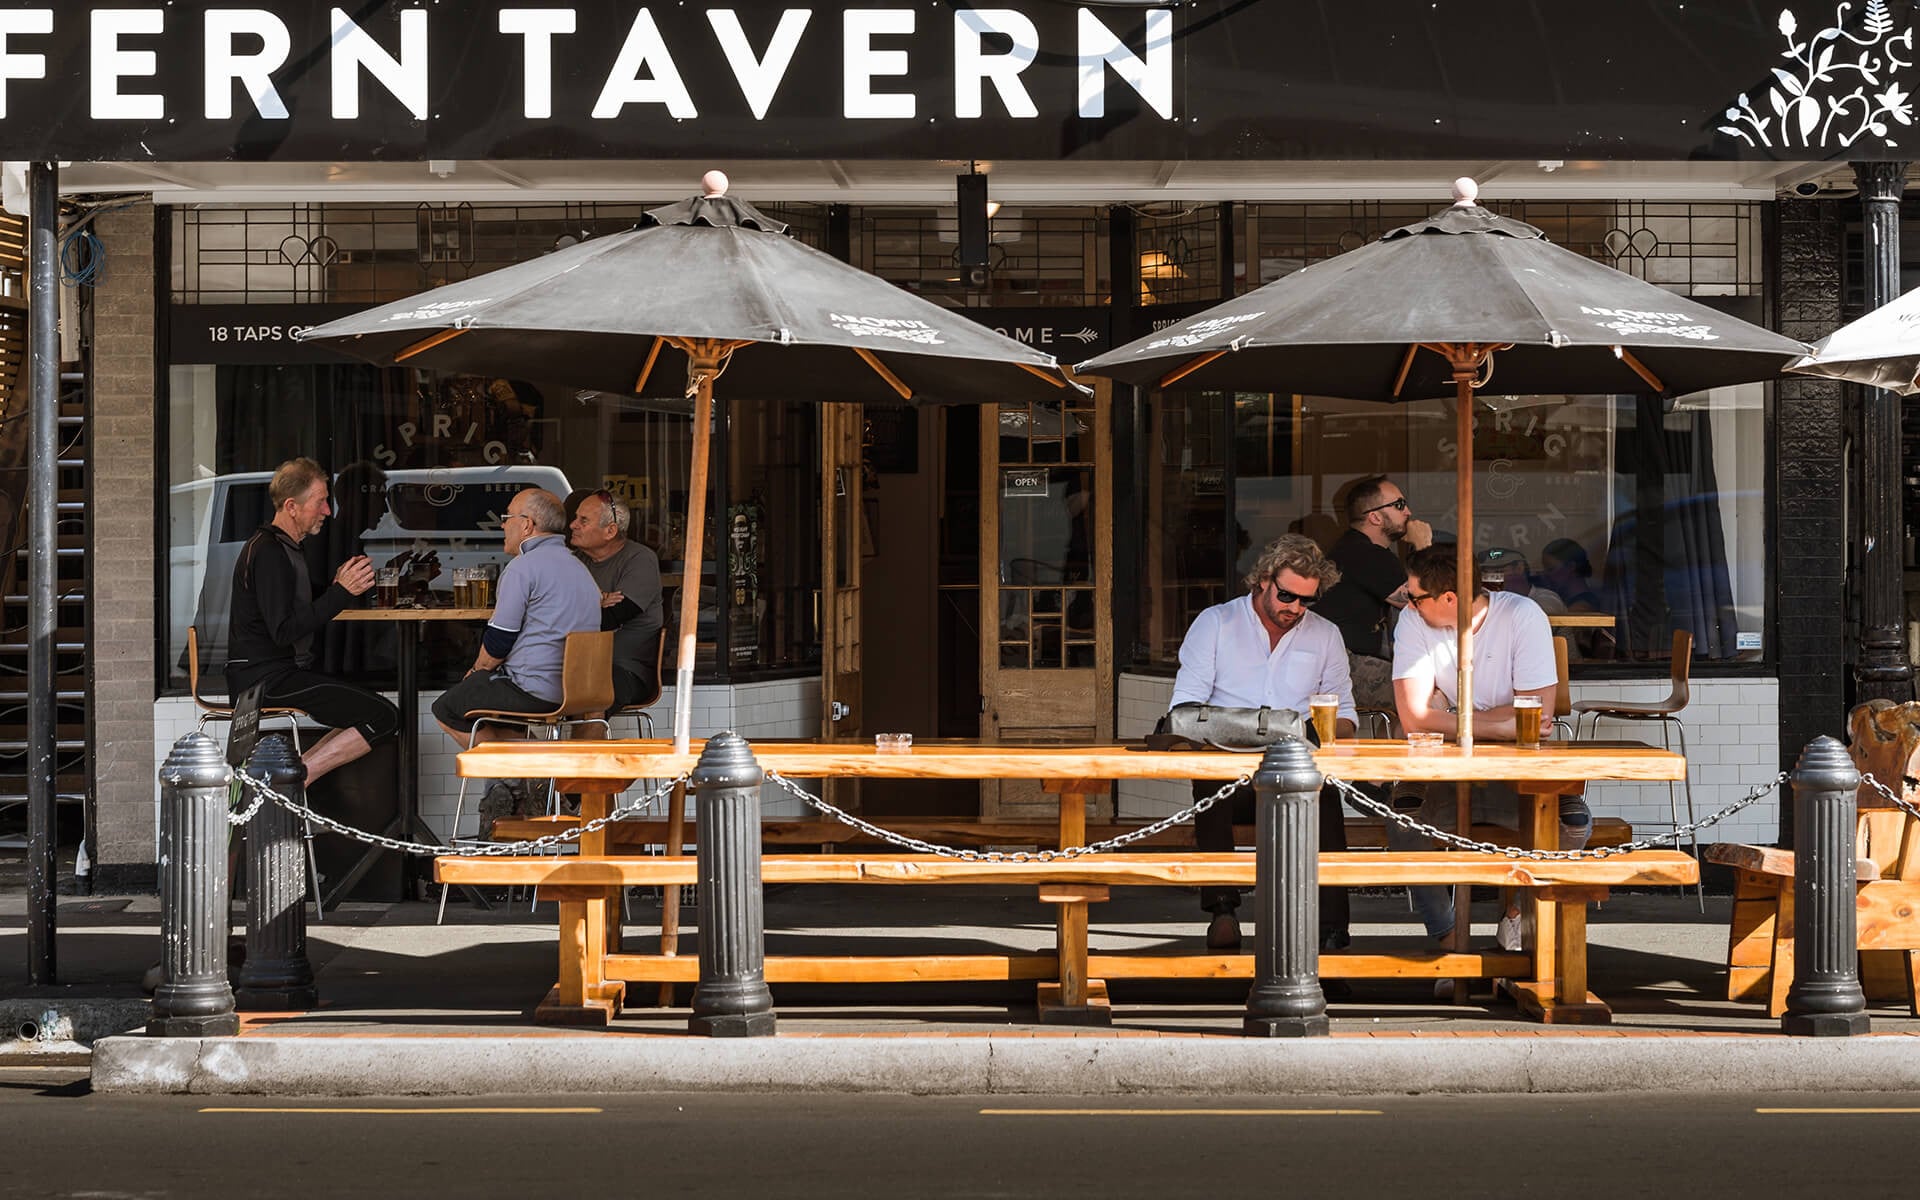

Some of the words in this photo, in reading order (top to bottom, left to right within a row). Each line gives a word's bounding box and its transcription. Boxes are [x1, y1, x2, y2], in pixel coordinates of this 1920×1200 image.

[0, 8, 429, 121] FERN
[498, 8, 1173, 121] TAVERN
[209, 327, 228, 342] 18
[233, 325, 282, 341] TAPS
[373, 414, 507, 466] SPRIG
[1014, 478, 1038, 487] OPEN
